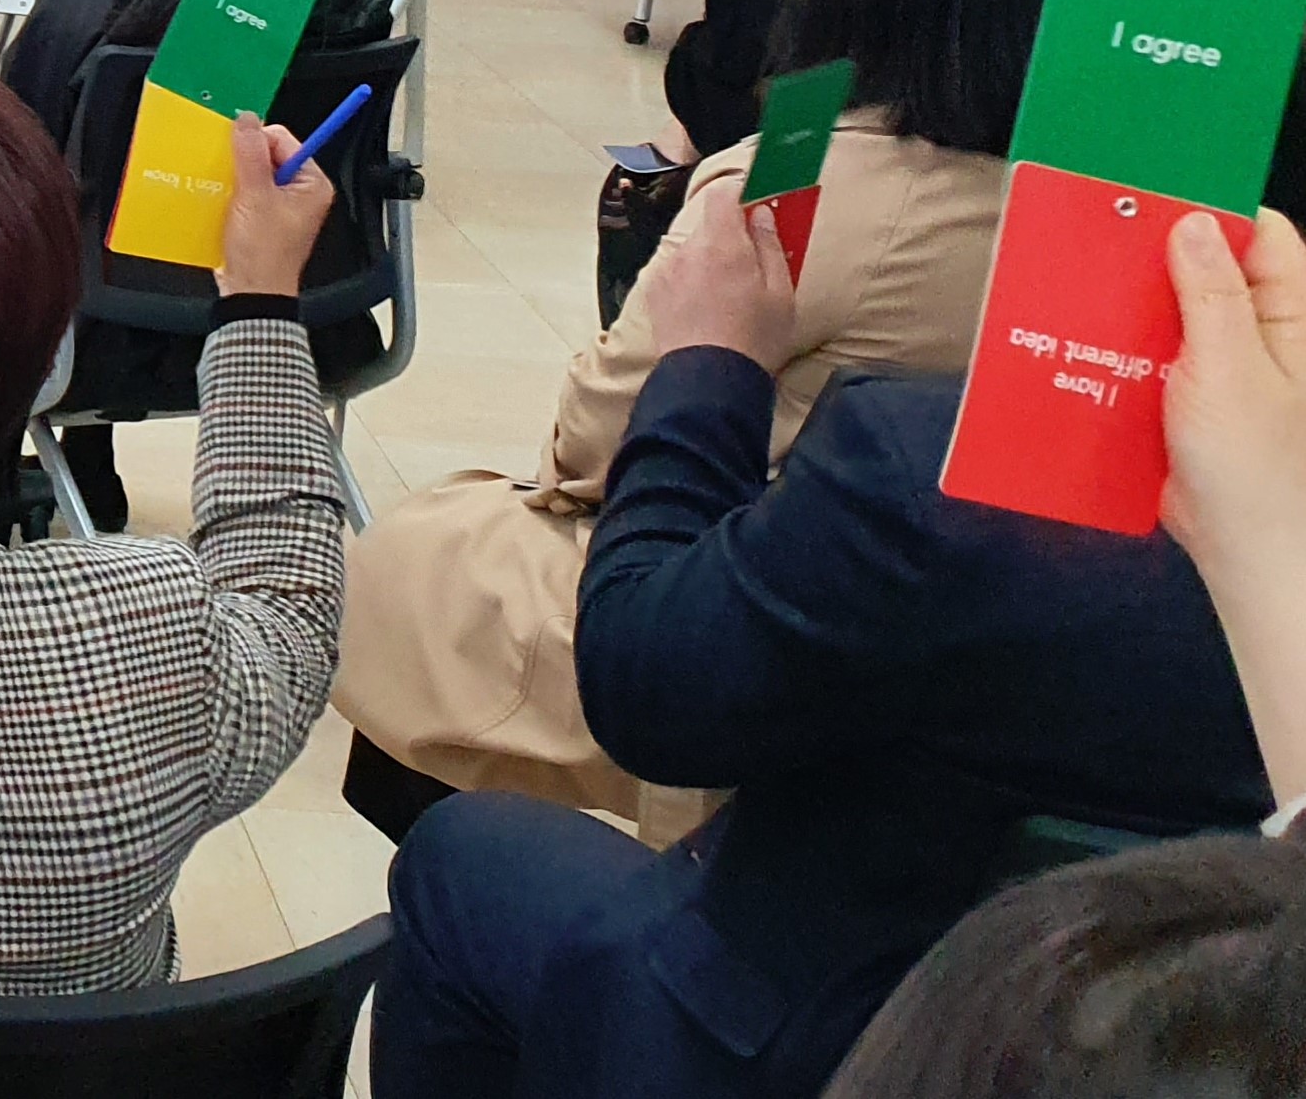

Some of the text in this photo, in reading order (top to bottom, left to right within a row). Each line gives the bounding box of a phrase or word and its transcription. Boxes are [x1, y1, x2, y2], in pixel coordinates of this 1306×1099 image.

[226, 4, 267, 30] agree
[1112, 21, 1222, 68] I agree
[1008, 327, 1059, 360] idea
[1064, 340, 1154, 382] different
[1052, 371, 1120, 407] I have
